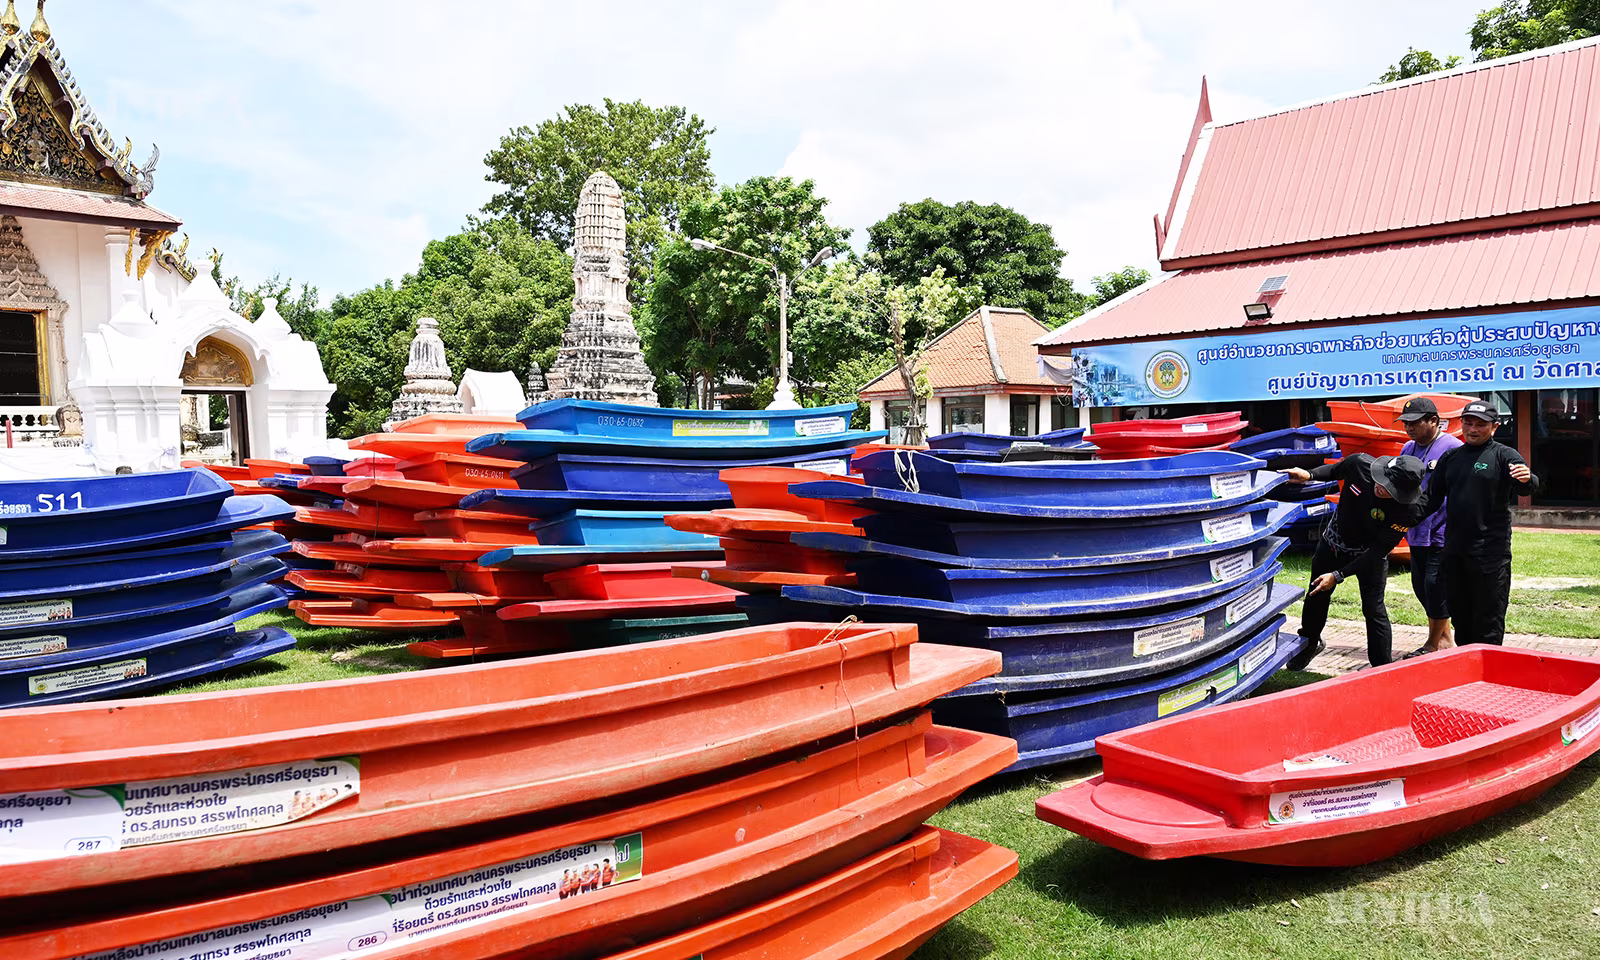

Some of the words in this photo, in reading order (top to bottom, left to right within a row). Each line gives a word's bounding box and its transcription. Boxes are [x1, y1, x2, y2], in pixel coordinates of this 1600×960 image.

[1197, 320, 1600, 365] ศูนย์อำนวยการเฉพาะกิจช่วยเหลือผู้ประสบปัญหา
[1382, 342, 1580, 365] เทศบาลนครพระนครศรีอยุธยา
[1267, 361, 1495, 396] ศูนย์บัญชาการเหตุการณ์
[1502, 365, 1525, 380] ณ
[38, 491, 84, 512] 511
[77, 841, 101, 851] 287
[357, 935, 378, 948] 286
